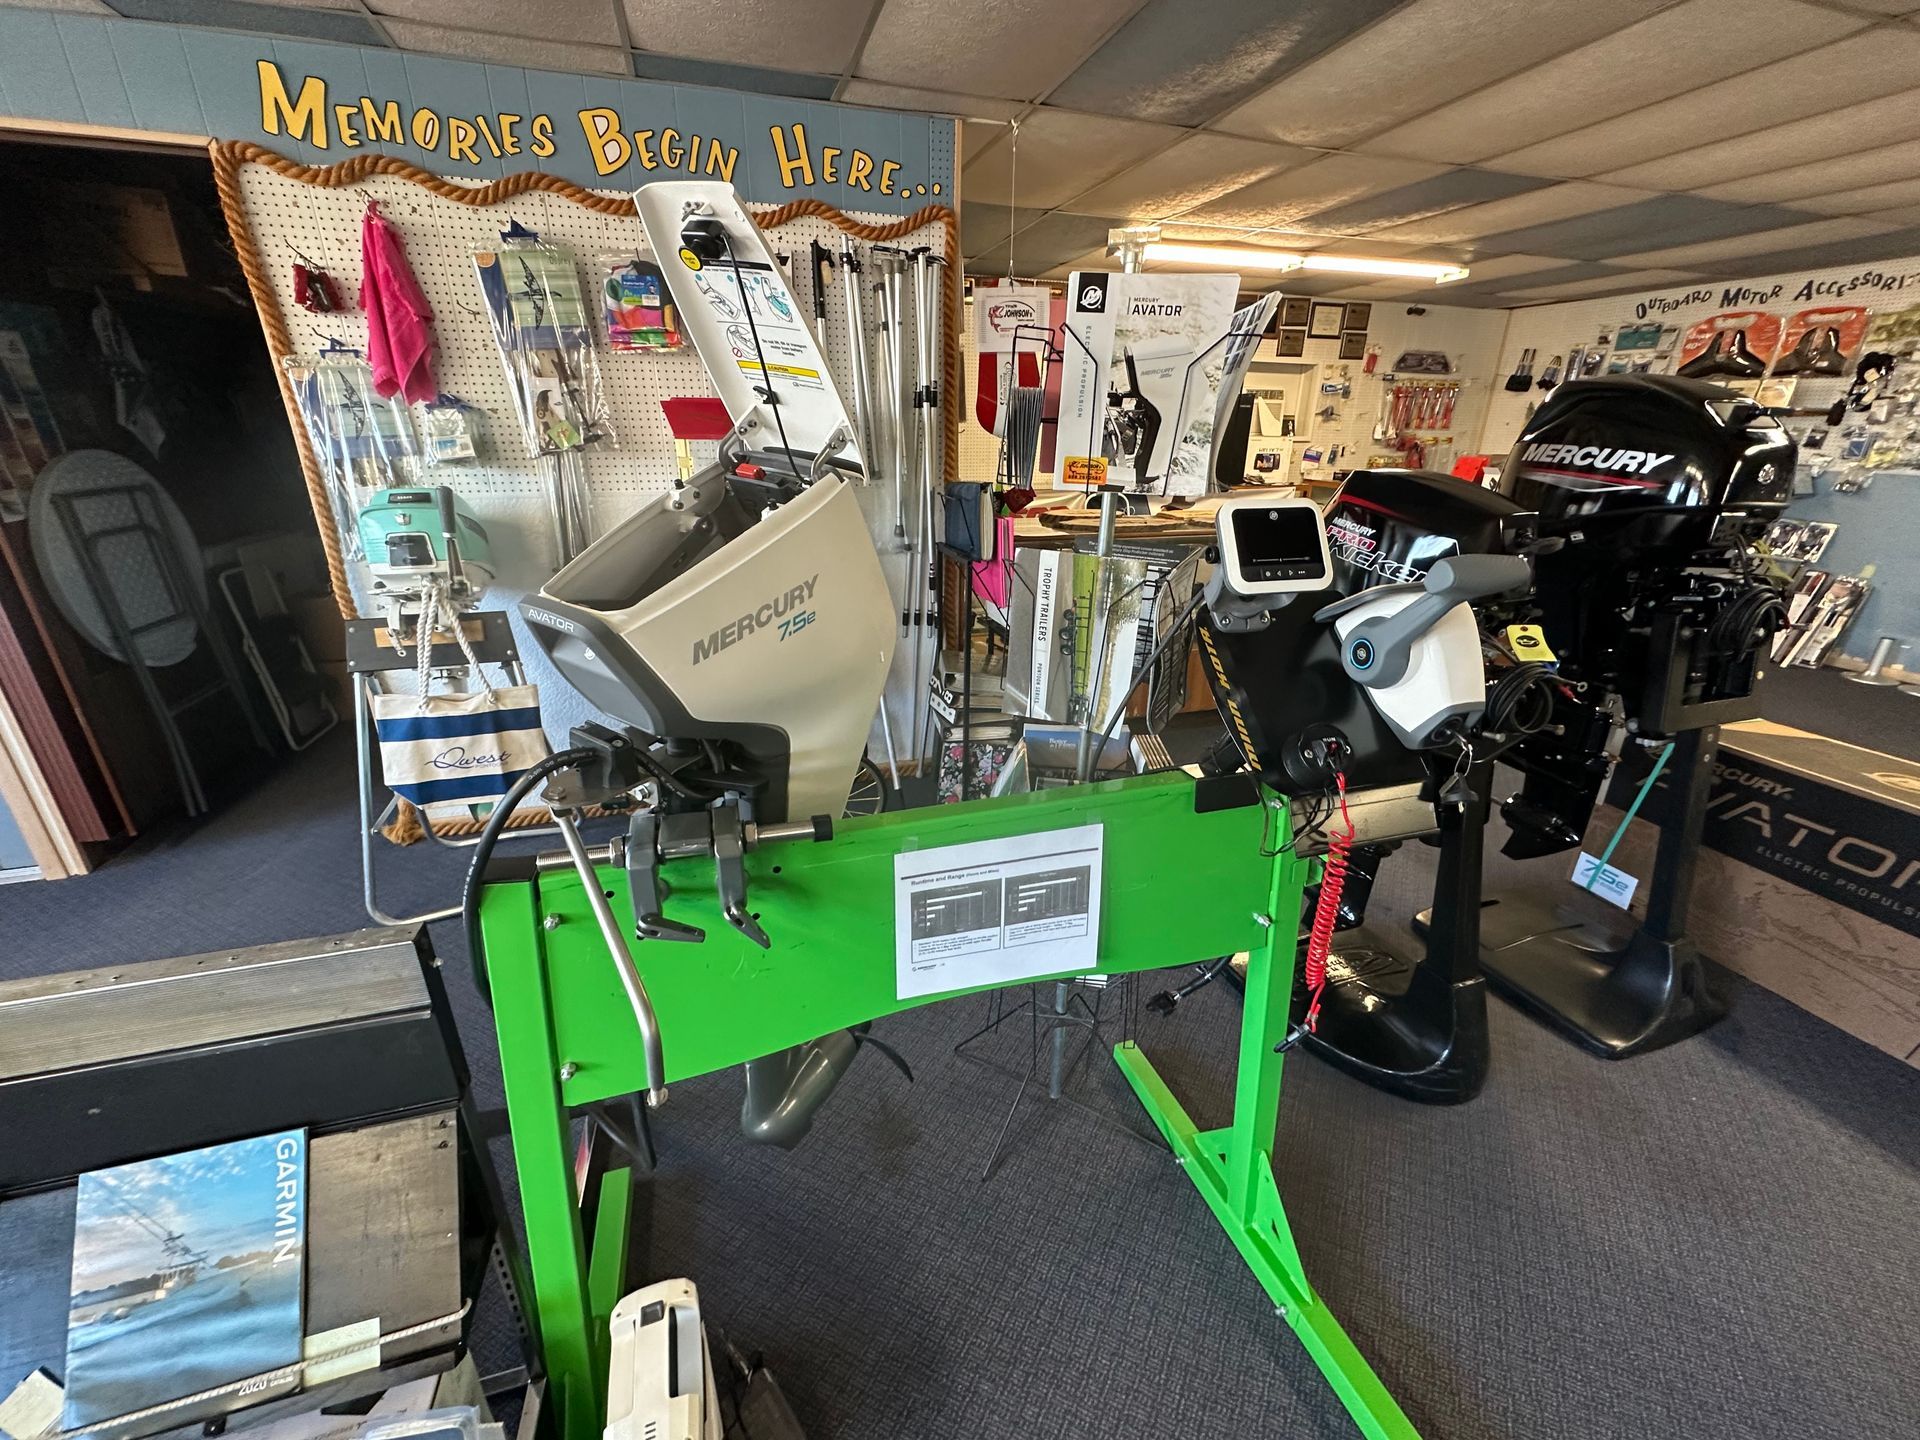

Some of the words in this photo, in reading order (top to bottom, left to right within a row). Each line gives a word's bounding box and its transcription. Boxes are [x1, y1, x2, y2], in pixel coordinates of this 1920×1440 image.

[257, 59, 557, 165] MEMORIES
[578, 107, 740, 182] BEGIN
[769, 122, 943, 200] HERE...
[1132, 304, 1183, 317] AVATOR
[1636, 290, 1713, 319] OUTBOARD
[1719, 285, 1785, 309] MOTOR
[1077, 367, 1088, 418] PROPULSION
[1521, 443, 1676, 475] MERCURY
[1326, 525, 1377, 552] PRO
[1332, 516, 1377, 537] MERCURY
[1041, 567, 1053, 602] TROPHY
[528, 608, 575, 633] AVATOR
[692, 573, 820, 666] MERCURY
[777, 609, 818, 643] 7.5e
[1037, 602, 1050, 642] TRAILERS
[1198, 626, 1231, 690] KOTA
[424, 746, 512, 769] Qwest
[1709, 763, 1795, 797] RCURY
[1583, 859, 1629, 892] 75e
[1756, 845, 1831, 882] ELECTRIC
[273, 1136, 299, 1262] GARMIN
